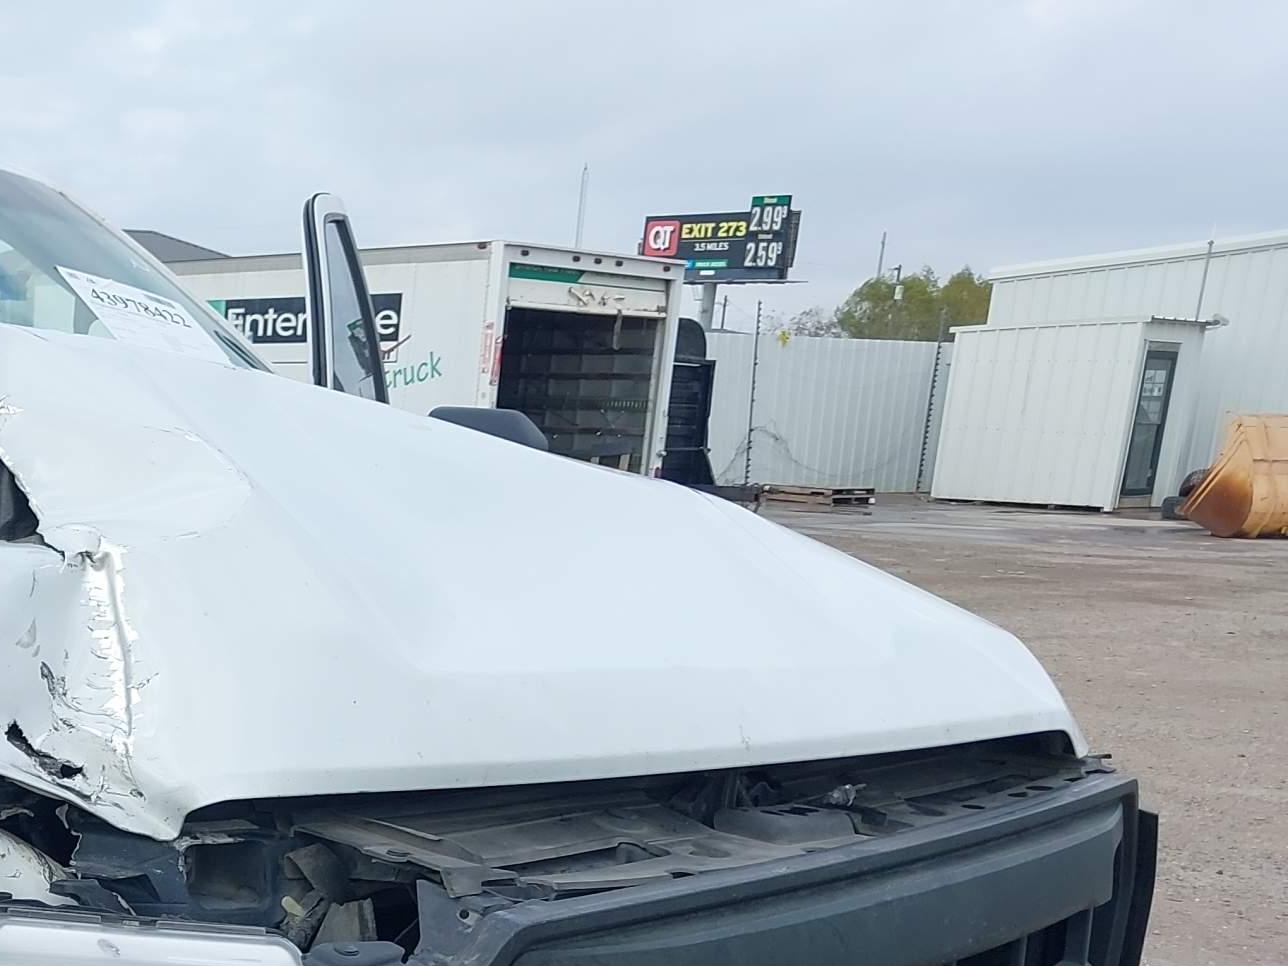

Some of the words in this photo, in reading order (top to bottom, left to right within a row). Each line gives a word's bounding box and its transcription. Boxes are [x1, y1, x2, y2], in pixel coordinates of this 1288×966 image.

[648, 225, 675, 250] QT
[681, 223, 715, 239] EXIT
[717, 222, 747, 237] 273
[707, 242, 729, 251] MILES
[91, 287, 193, 329] 43978422
